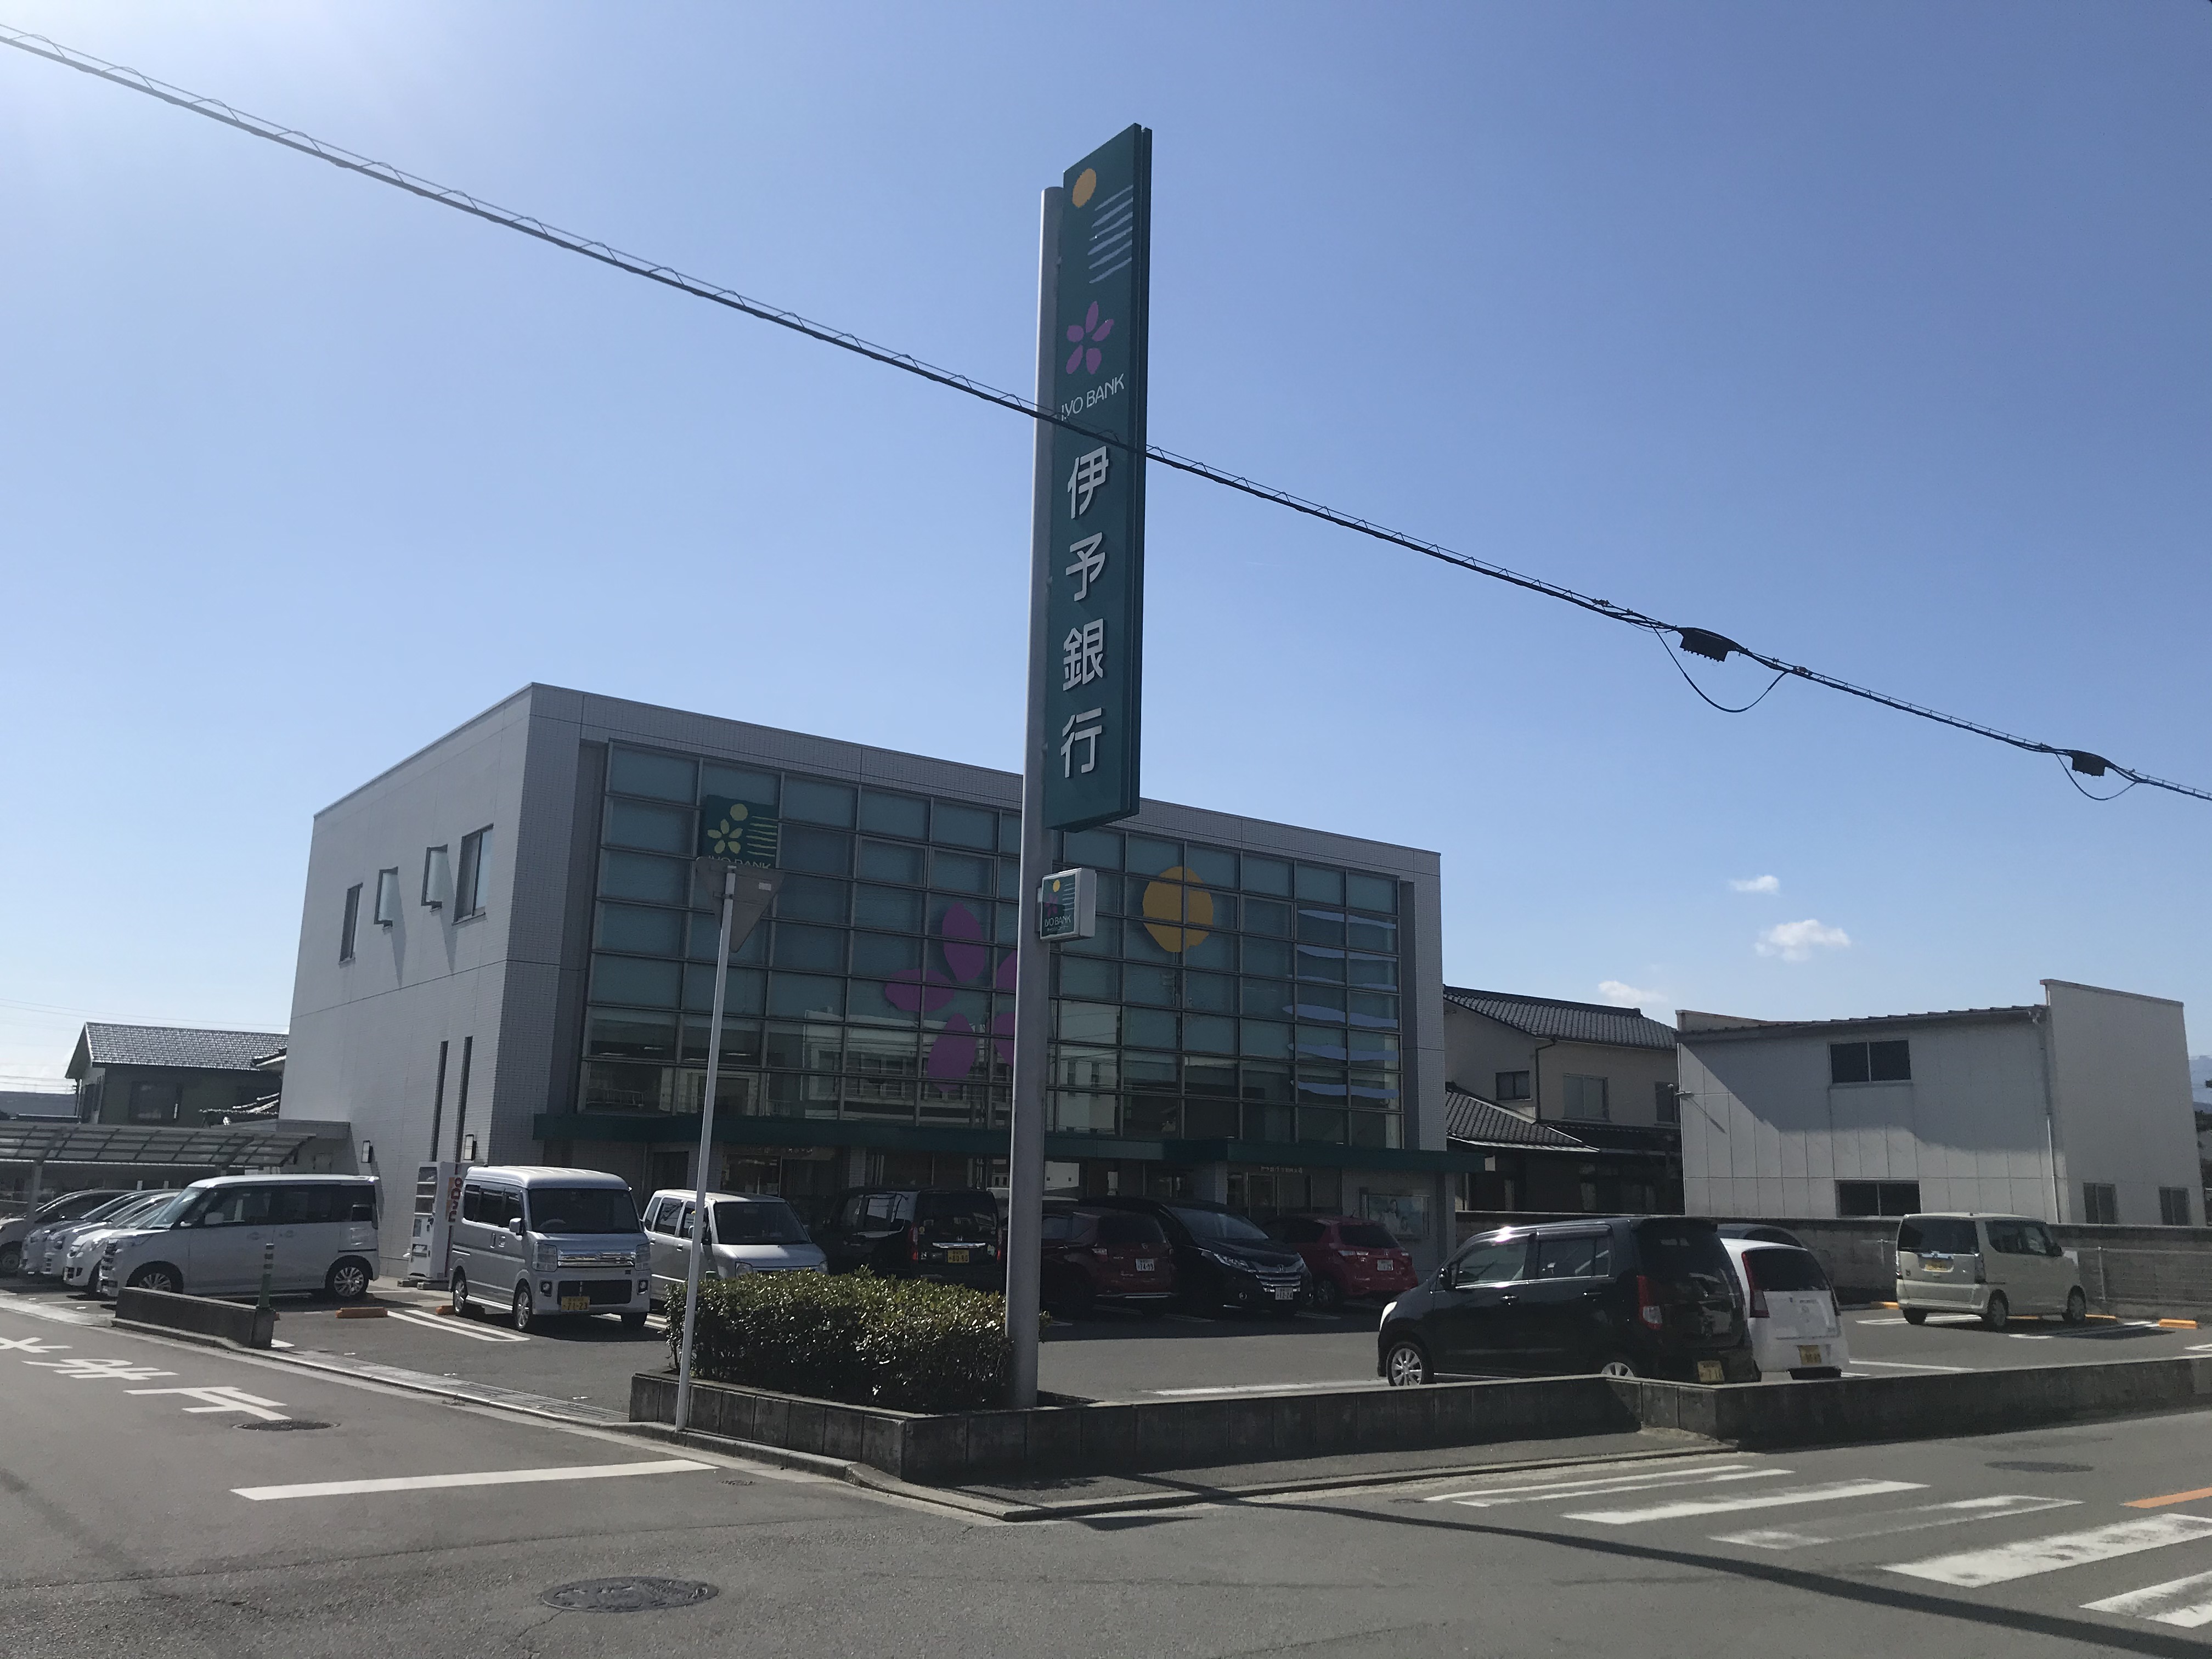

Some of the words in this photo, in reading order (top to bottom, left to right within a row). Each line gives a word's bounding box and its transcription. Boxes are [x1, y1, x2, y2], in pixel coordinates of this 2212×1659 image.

[1061, 396, 1083, 421] IYO
[1086, 373, 1125, 407] BANK
[1060, 445, 1110, 778] 伊予銀行
[1045, 918, 1054, 927] IYO
[1055, 915, 1071, 925] BANK
